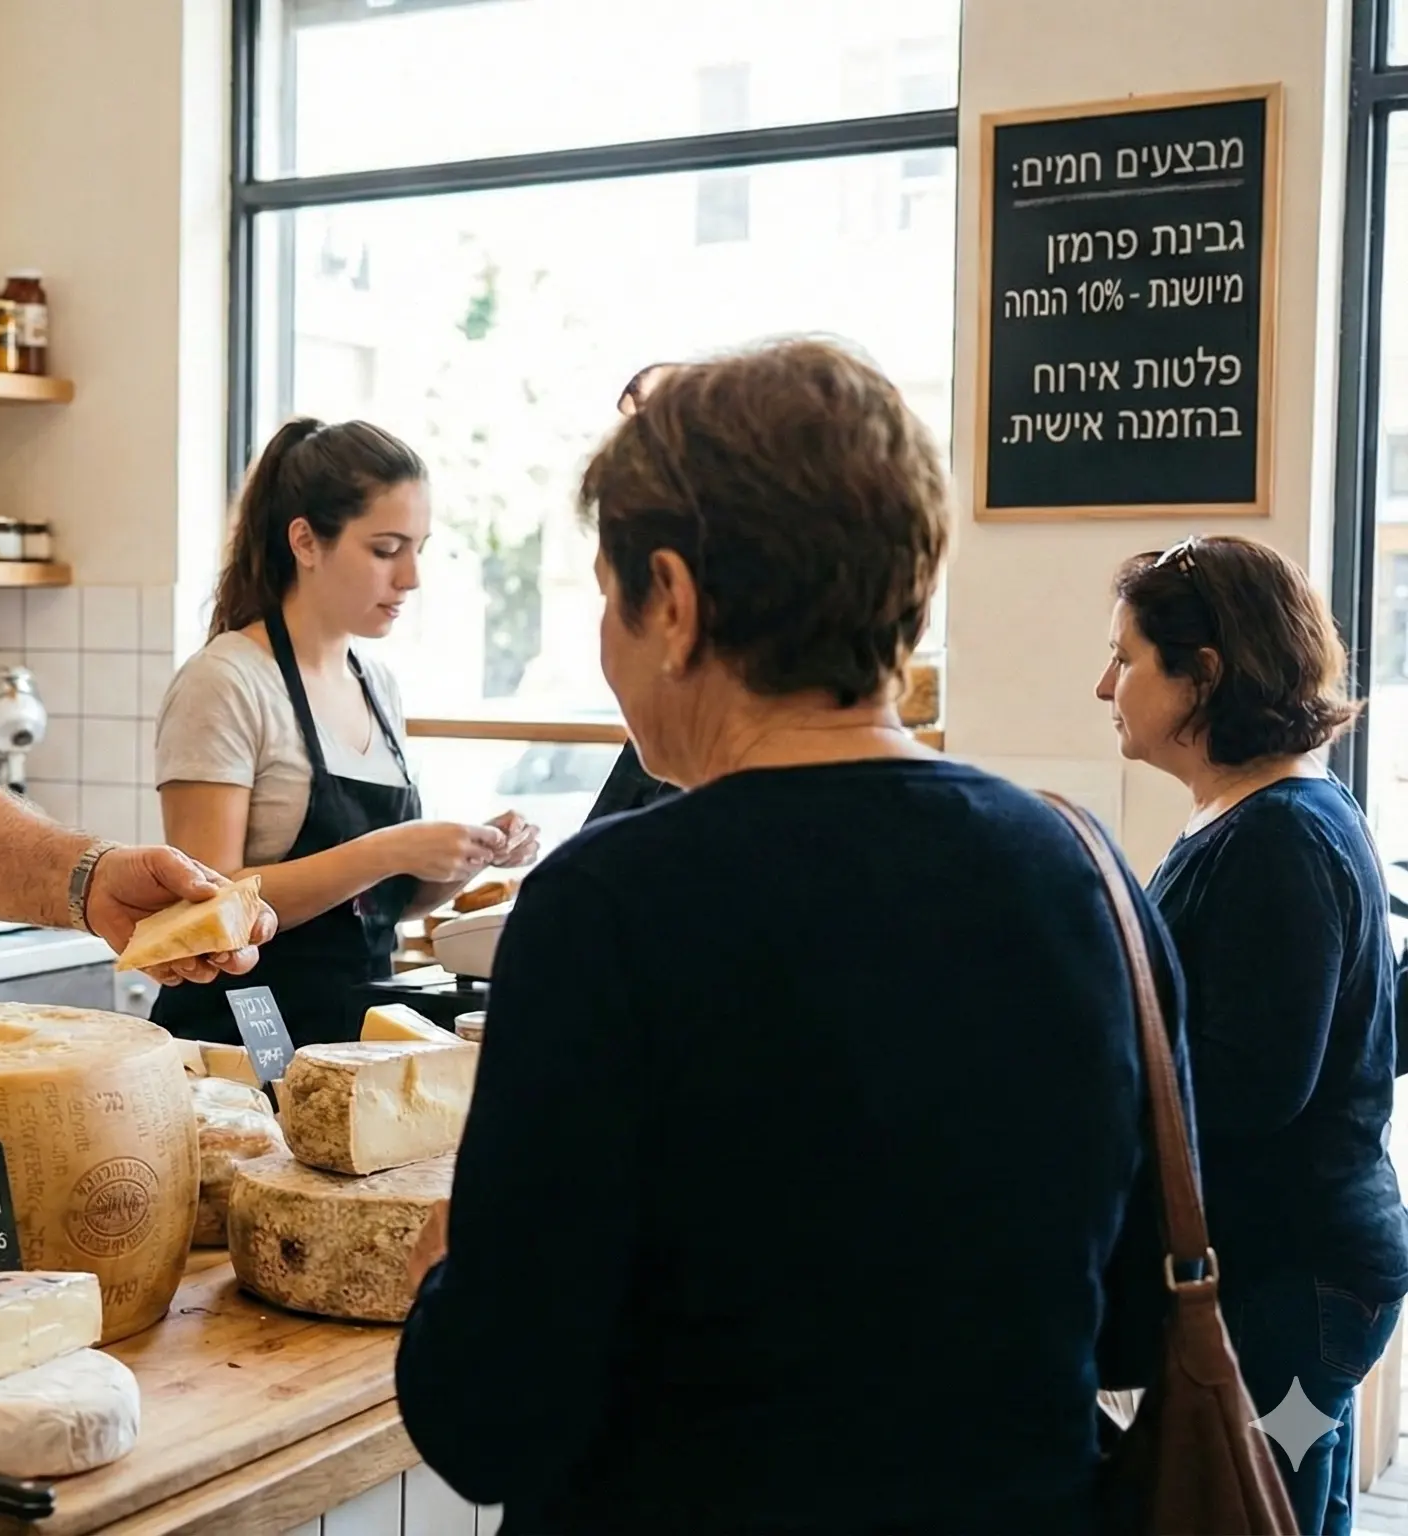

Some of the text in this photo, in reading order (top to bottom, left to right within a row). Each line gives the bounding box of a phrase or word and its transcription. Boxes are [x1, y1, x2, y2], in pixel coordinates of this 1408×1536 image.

[1012, 138, 1243, 188] מבצעים חמים:
[1048, 220, 1245, 274] גבינת פרמזן
[1005, 287, 1067, 318] הנחה
[1148, 274, 1243, 308] מיושנת
[1034, 346, 1241, 394] פלטות אירוח
[1002, 406, 1242, 444] בהזמנה אישית.
